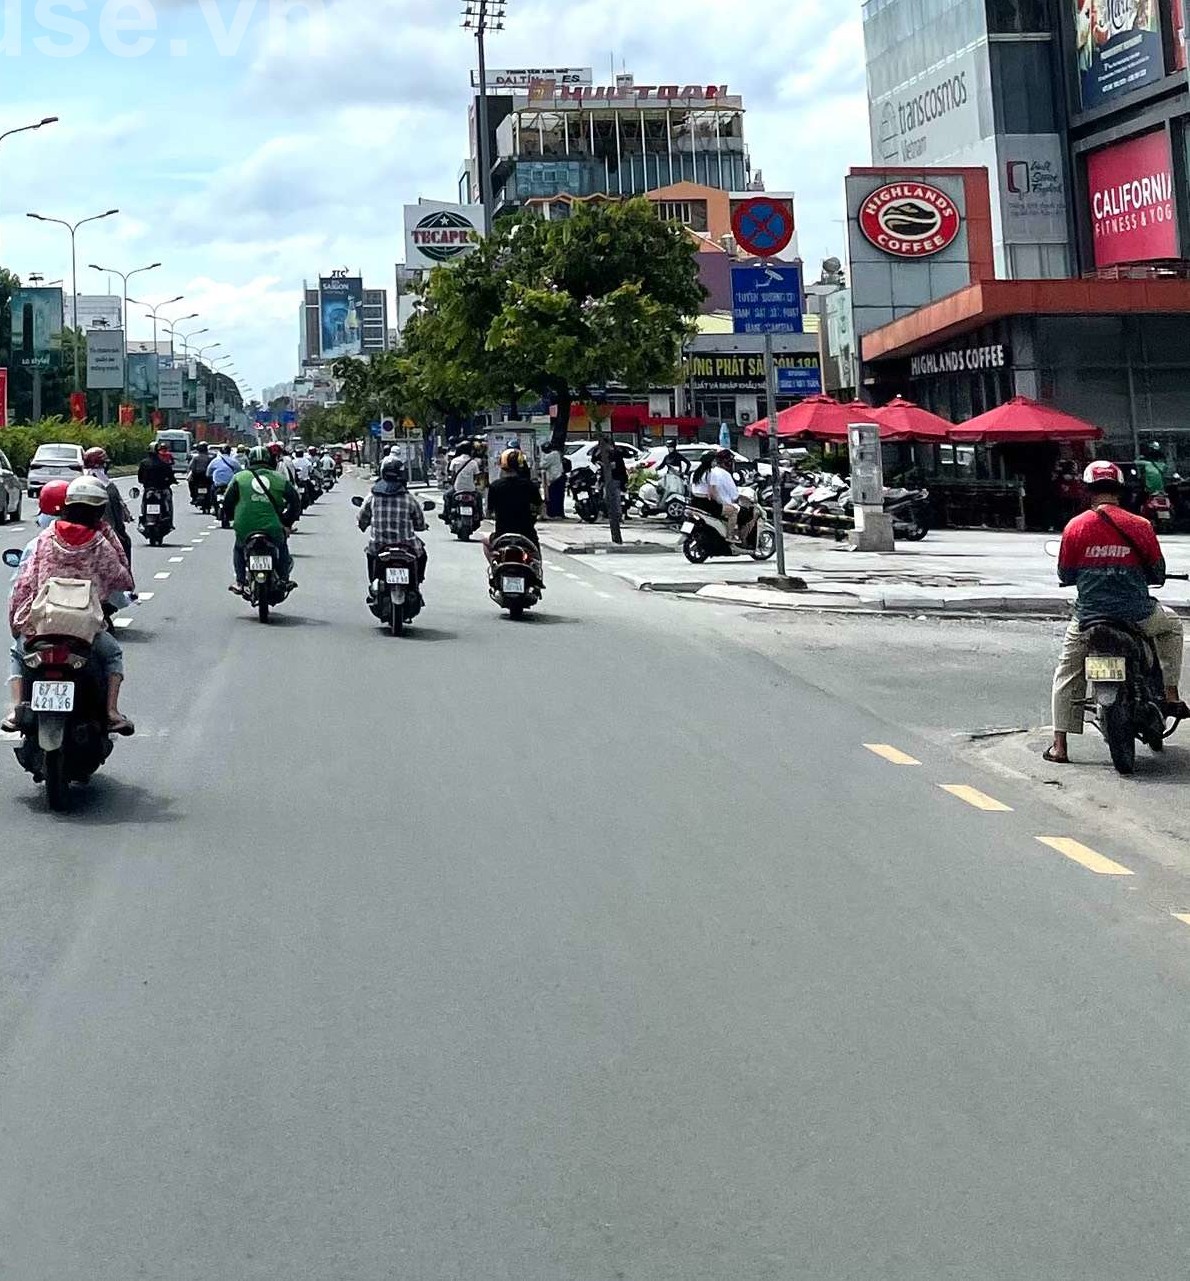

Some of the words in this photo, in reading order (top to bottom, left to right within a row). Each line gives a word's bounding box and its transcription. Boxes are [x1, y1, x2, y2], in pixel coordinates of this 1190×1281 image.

[899, 71, 967, 135] transcosmos
[866, 186, 954, 216] HIGHLANDS
[411, 230, 478, 244] TECAPR
[1095, 213, 1137, 238] FITNESS
[877, 234, 945, 252] COFFEE
[716, 354, 745, 376] PHÁT
[748, 354, 764, 376] SÀ
[911, 350, 965, 375] HIGHLANDS
[966, 344, 1005, 369] COFFEE
